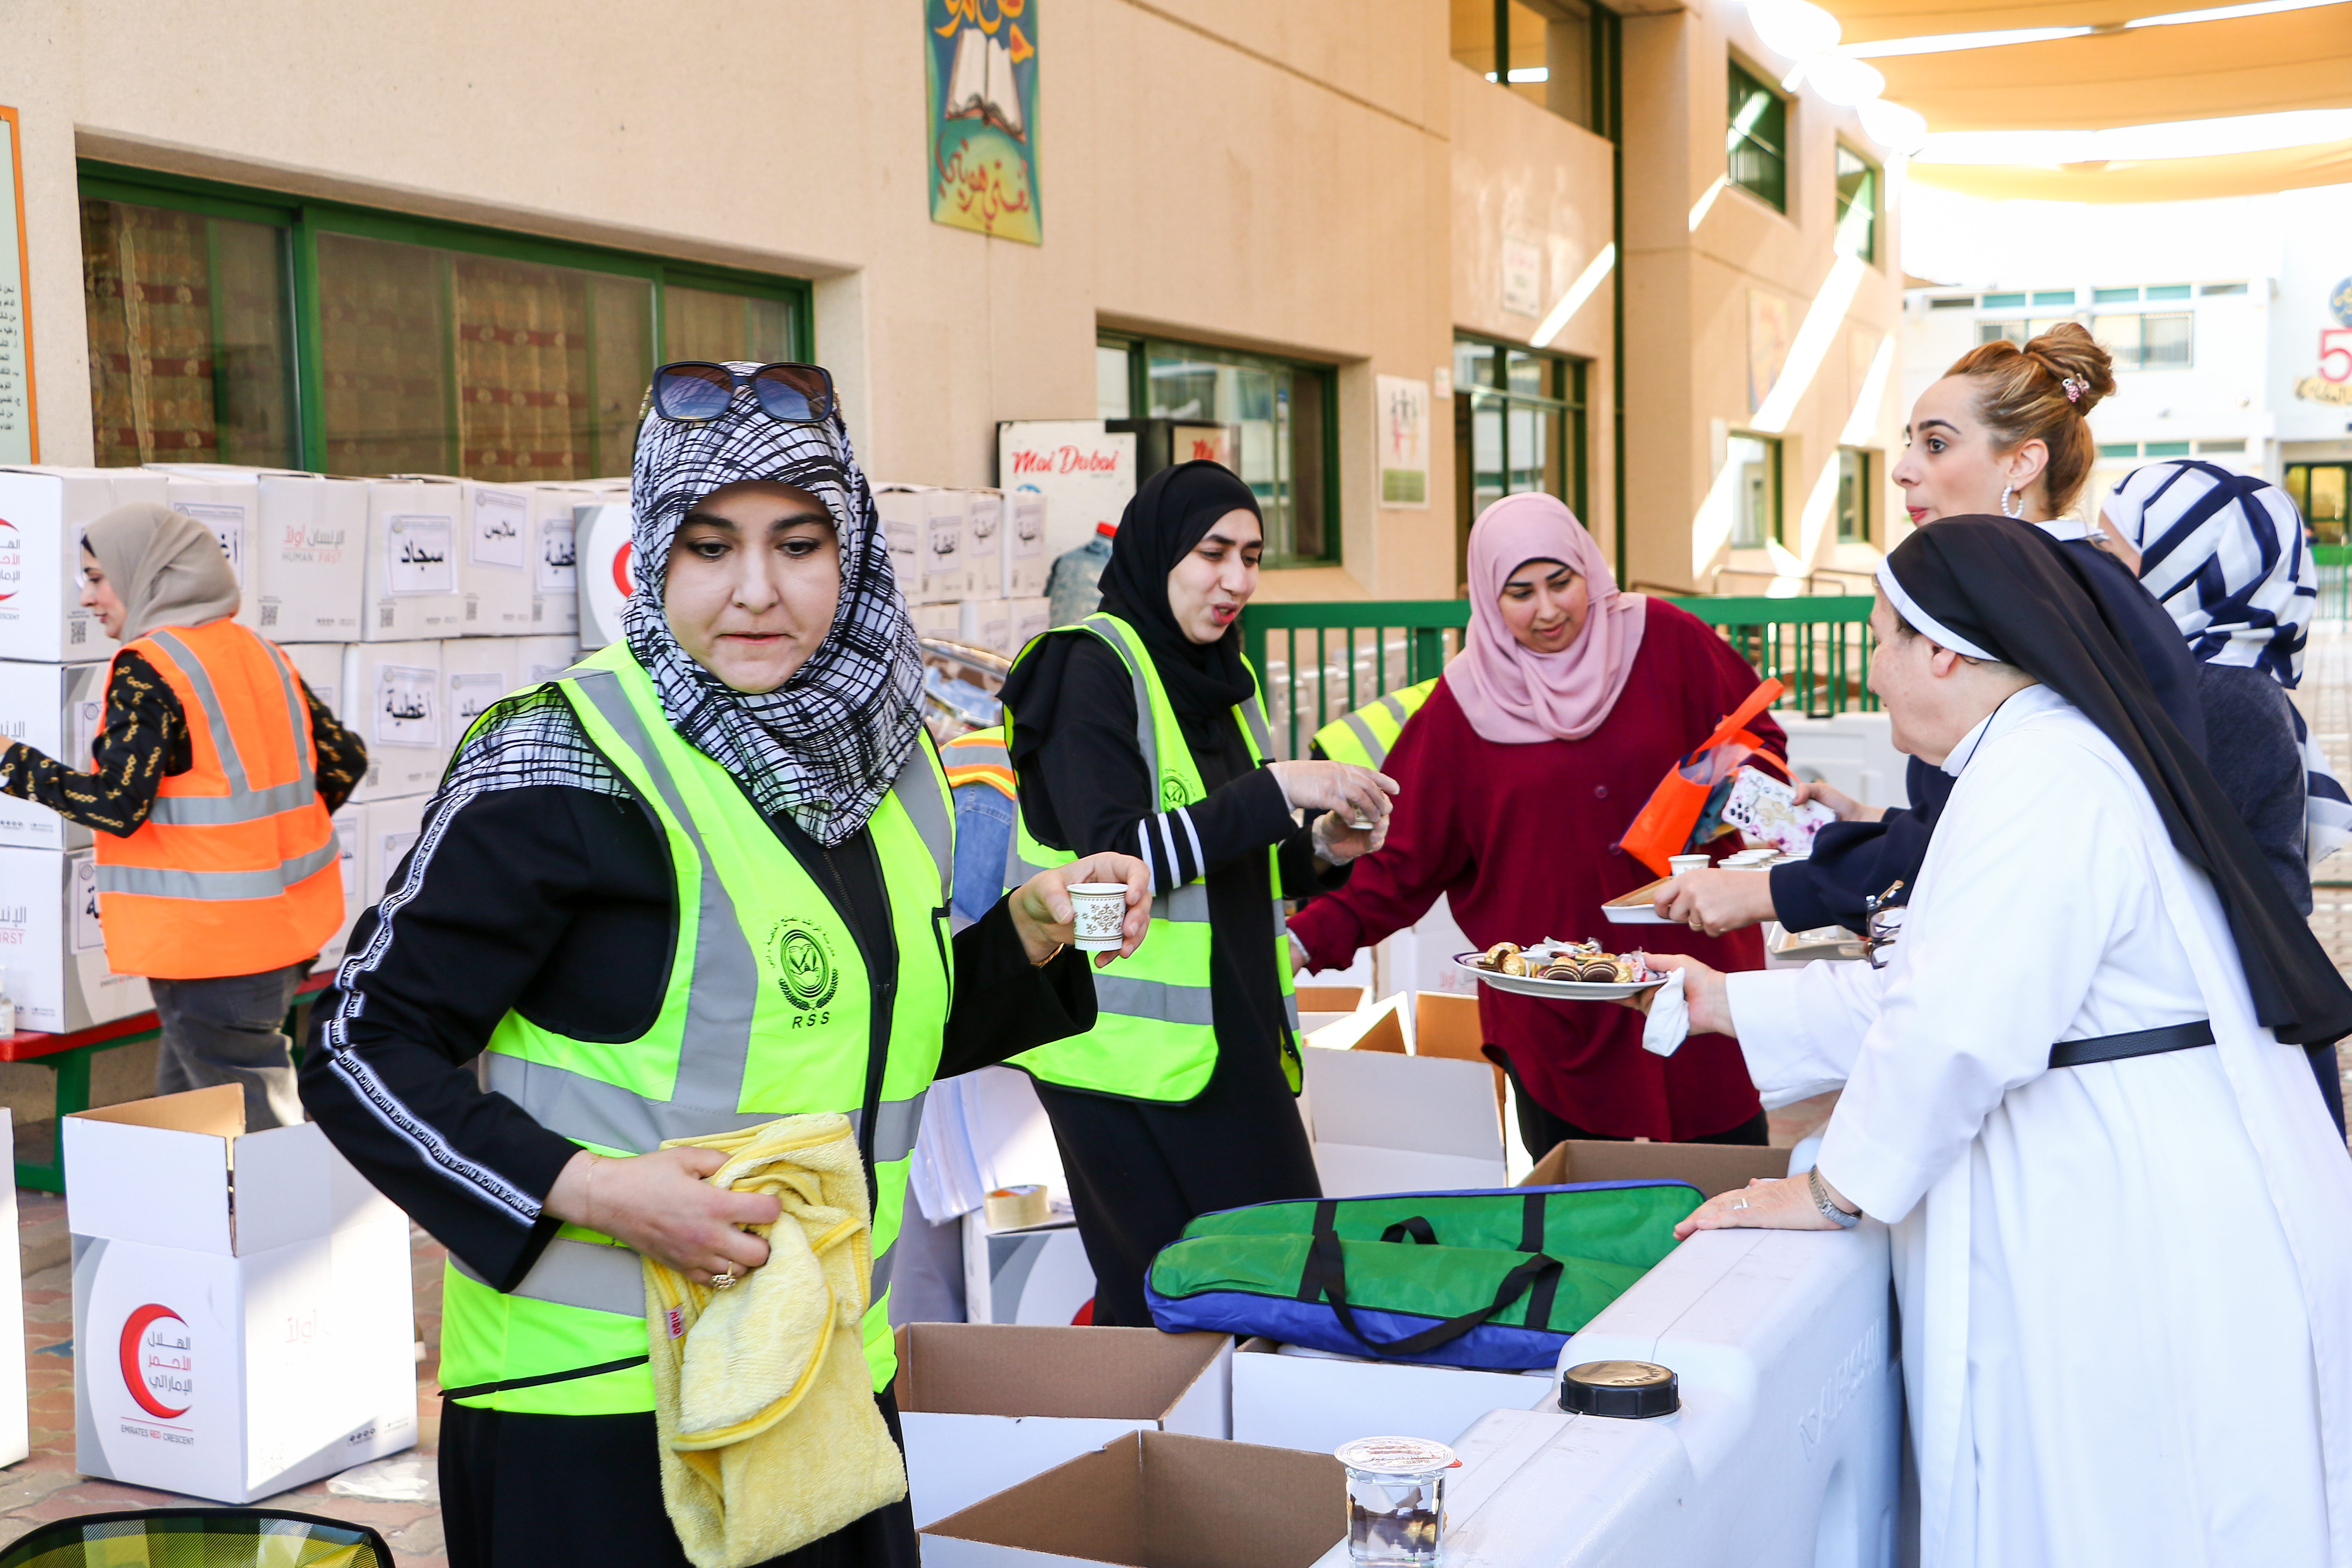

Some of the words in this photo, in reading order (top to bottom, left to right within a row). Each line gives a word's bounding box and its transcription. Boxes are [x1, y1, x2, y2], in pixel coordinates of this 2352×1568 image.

[1011, 450, 1056, 474] Mai
[1059, 445, 1118, 474] Dubai
[484, 520, 516, 540] ملابس
[401, 539, 444, 571] سجاد
[545, 540, 575, 574] غطية
[386, 688, 432, 726] أغطية
[670, 1311, 682, 1335] NIDO
[147, 1331, 191, 1351] الهلال
[149, 1354, 191, 1372] الأحمر
[149, 1375, 193, 1396] الإماراتي
[121, 1424, 149, 1438] EMIRATES
[150, 1429, 161, 1439] RED
[163, 1433, 194, 1445] CRESCENT
